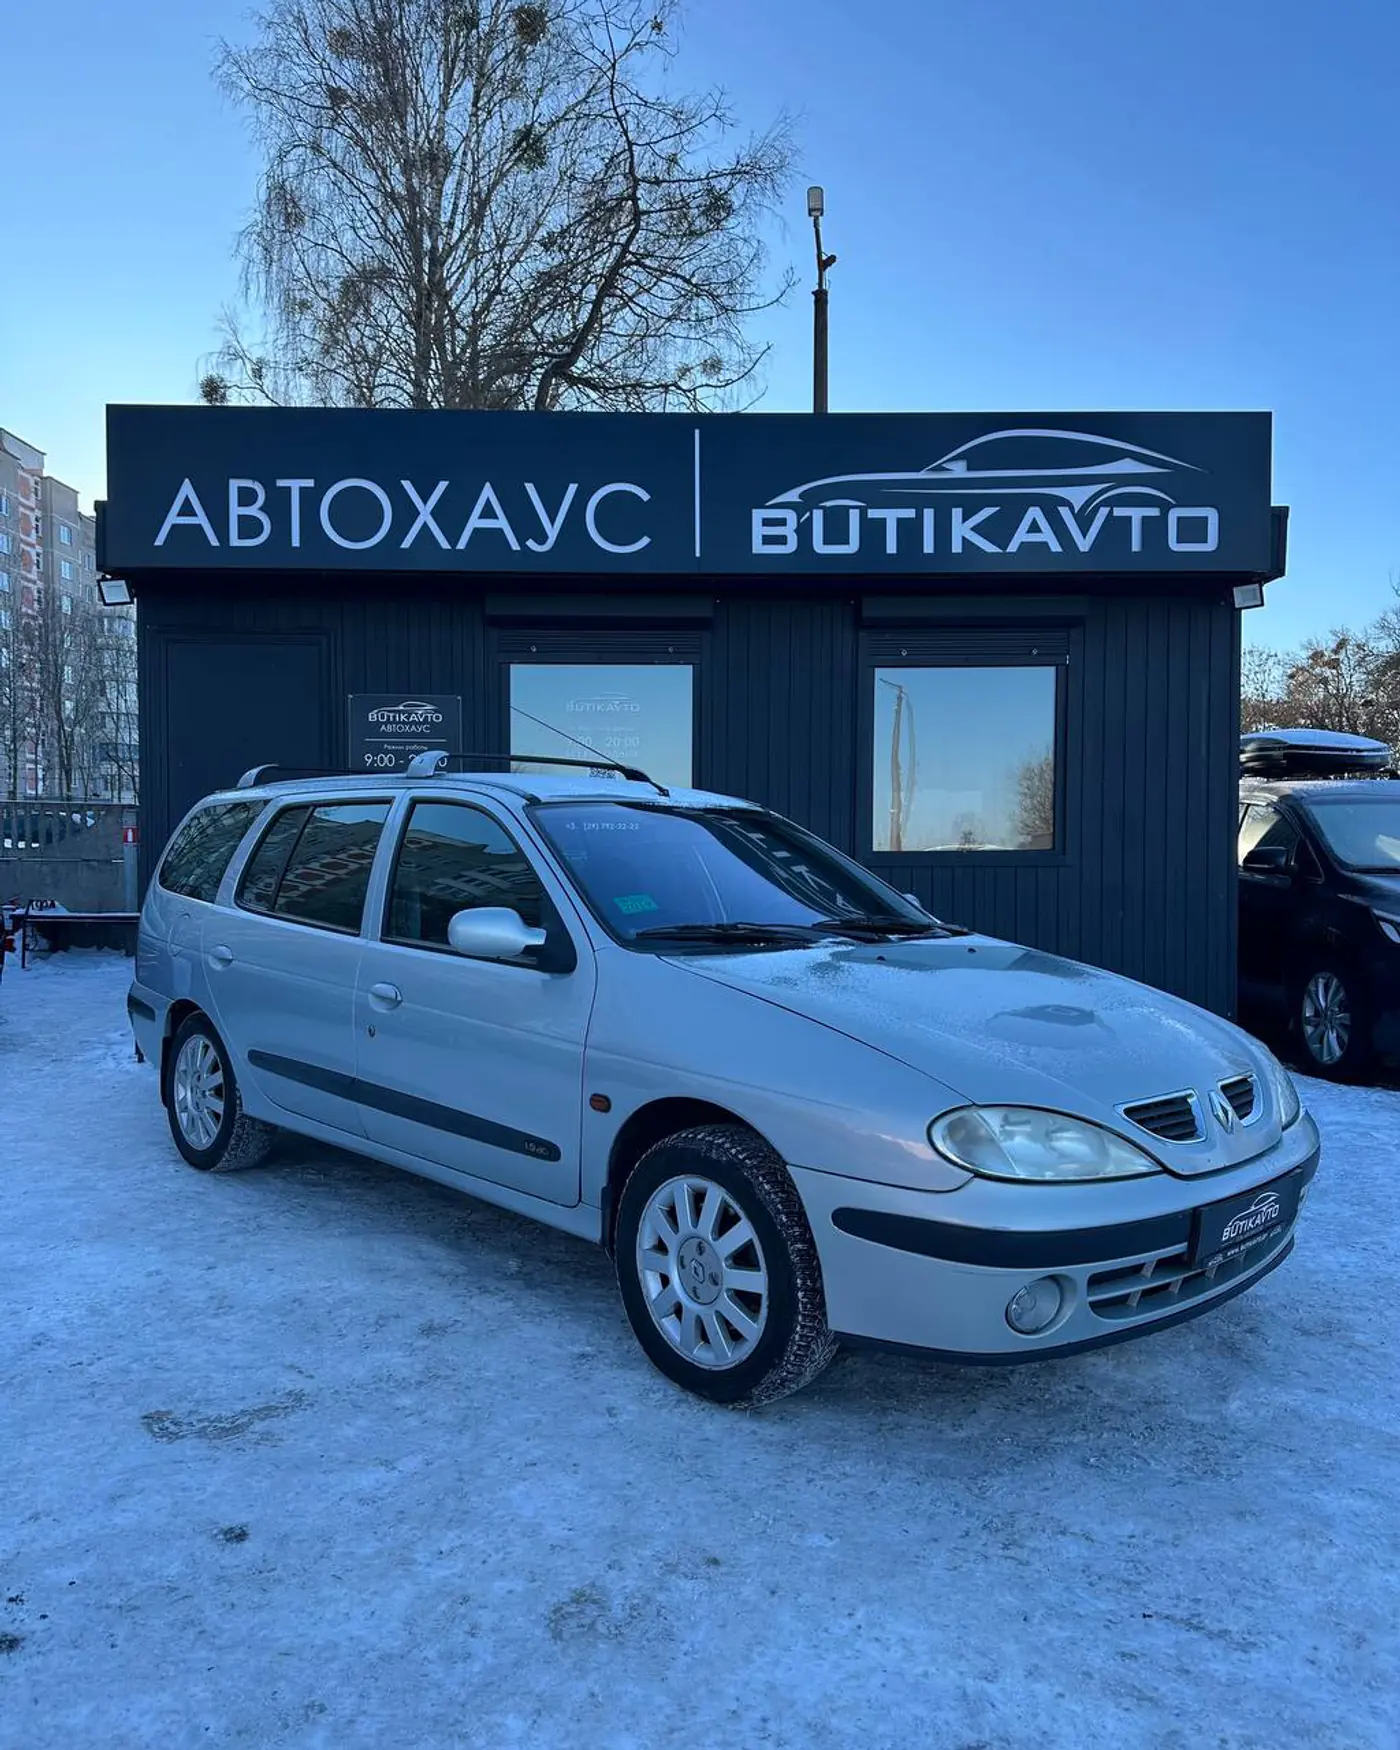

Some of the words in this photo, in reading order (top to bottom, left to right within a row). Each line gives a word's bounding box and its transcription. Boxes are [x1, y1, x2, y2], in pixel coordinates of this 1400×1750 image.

[154, 477, 651, 554] АВТОХАУС
[751, 505, 1220, 555] BUTIKAVTO
[368, 712, 443, 722] BUTIKAVTO
[380, 724, 431, 733] АВТОХАУС
[364, 753, 395, 767] 9:00
[1222, 1204, 1280, 1241] BUTIKAVTO
